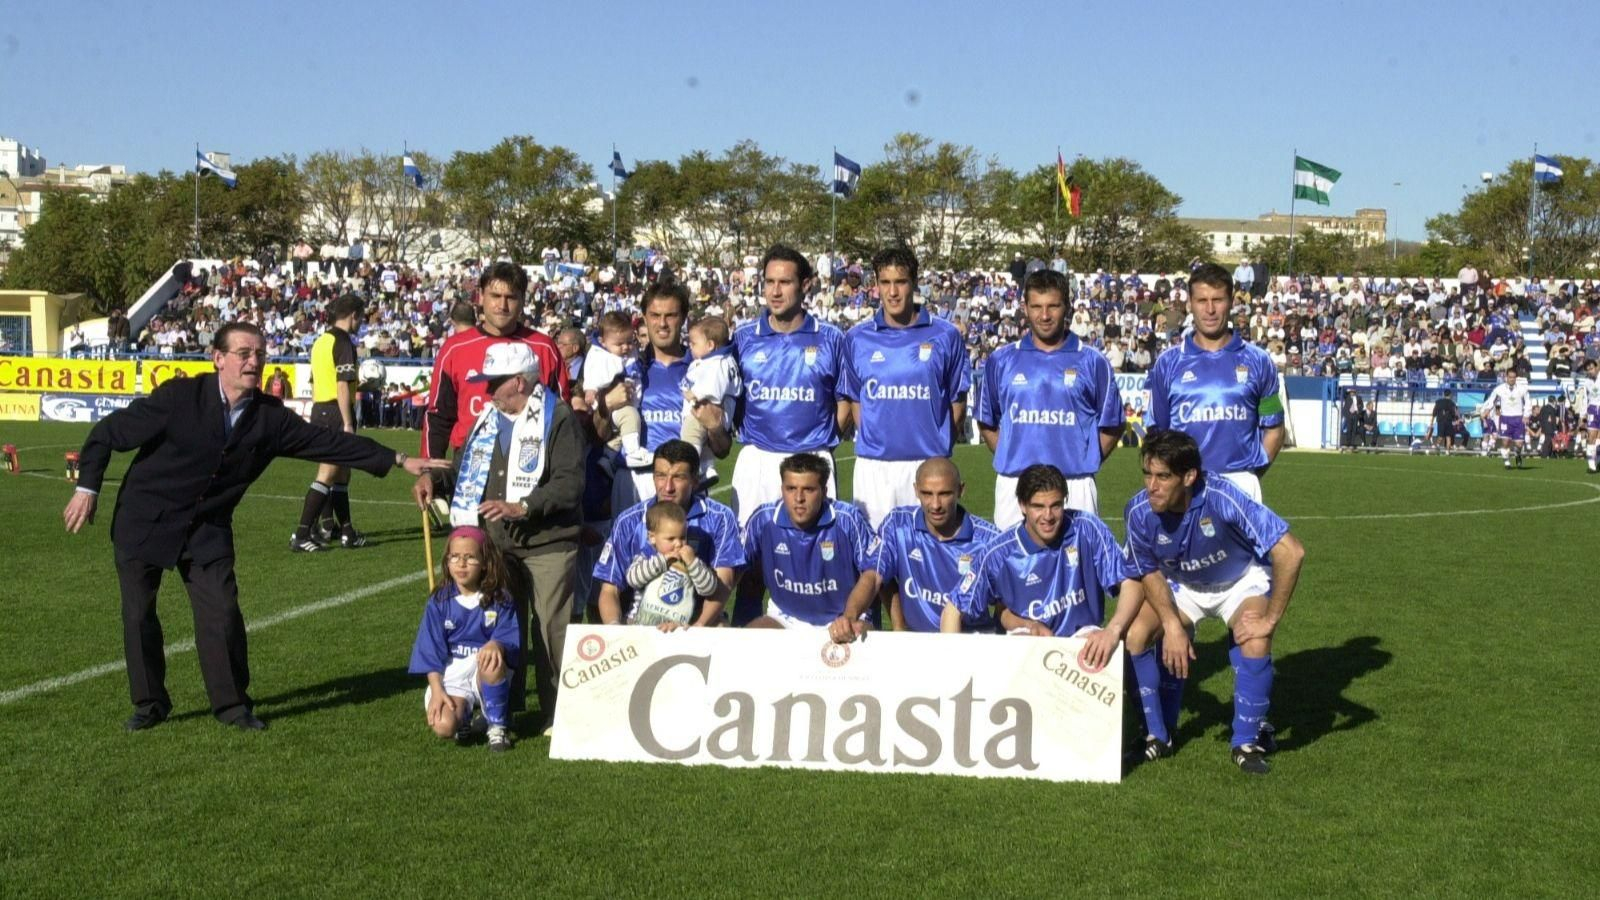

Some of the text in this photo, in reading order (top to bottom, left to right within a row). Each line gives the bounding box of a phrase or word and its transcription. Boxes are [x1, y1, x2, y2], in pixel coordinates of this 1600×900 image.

[749, 380, 815, 402] Canasta
[866, 378, 930, 400] Canasta
[643, 410, 681, 422] anas
[1009, 402, 1076, 426] Canasta
[1178, 401, 1248, 424] Canasta
[774, 568, 838, 595] Canasta
[1028, 588, 1086, 620] Canasta
[561, 644, 639, 689] Canasta
[1042, 649, 1117, 707] Canasta
[628, 654, 1040, 770] Canasta
